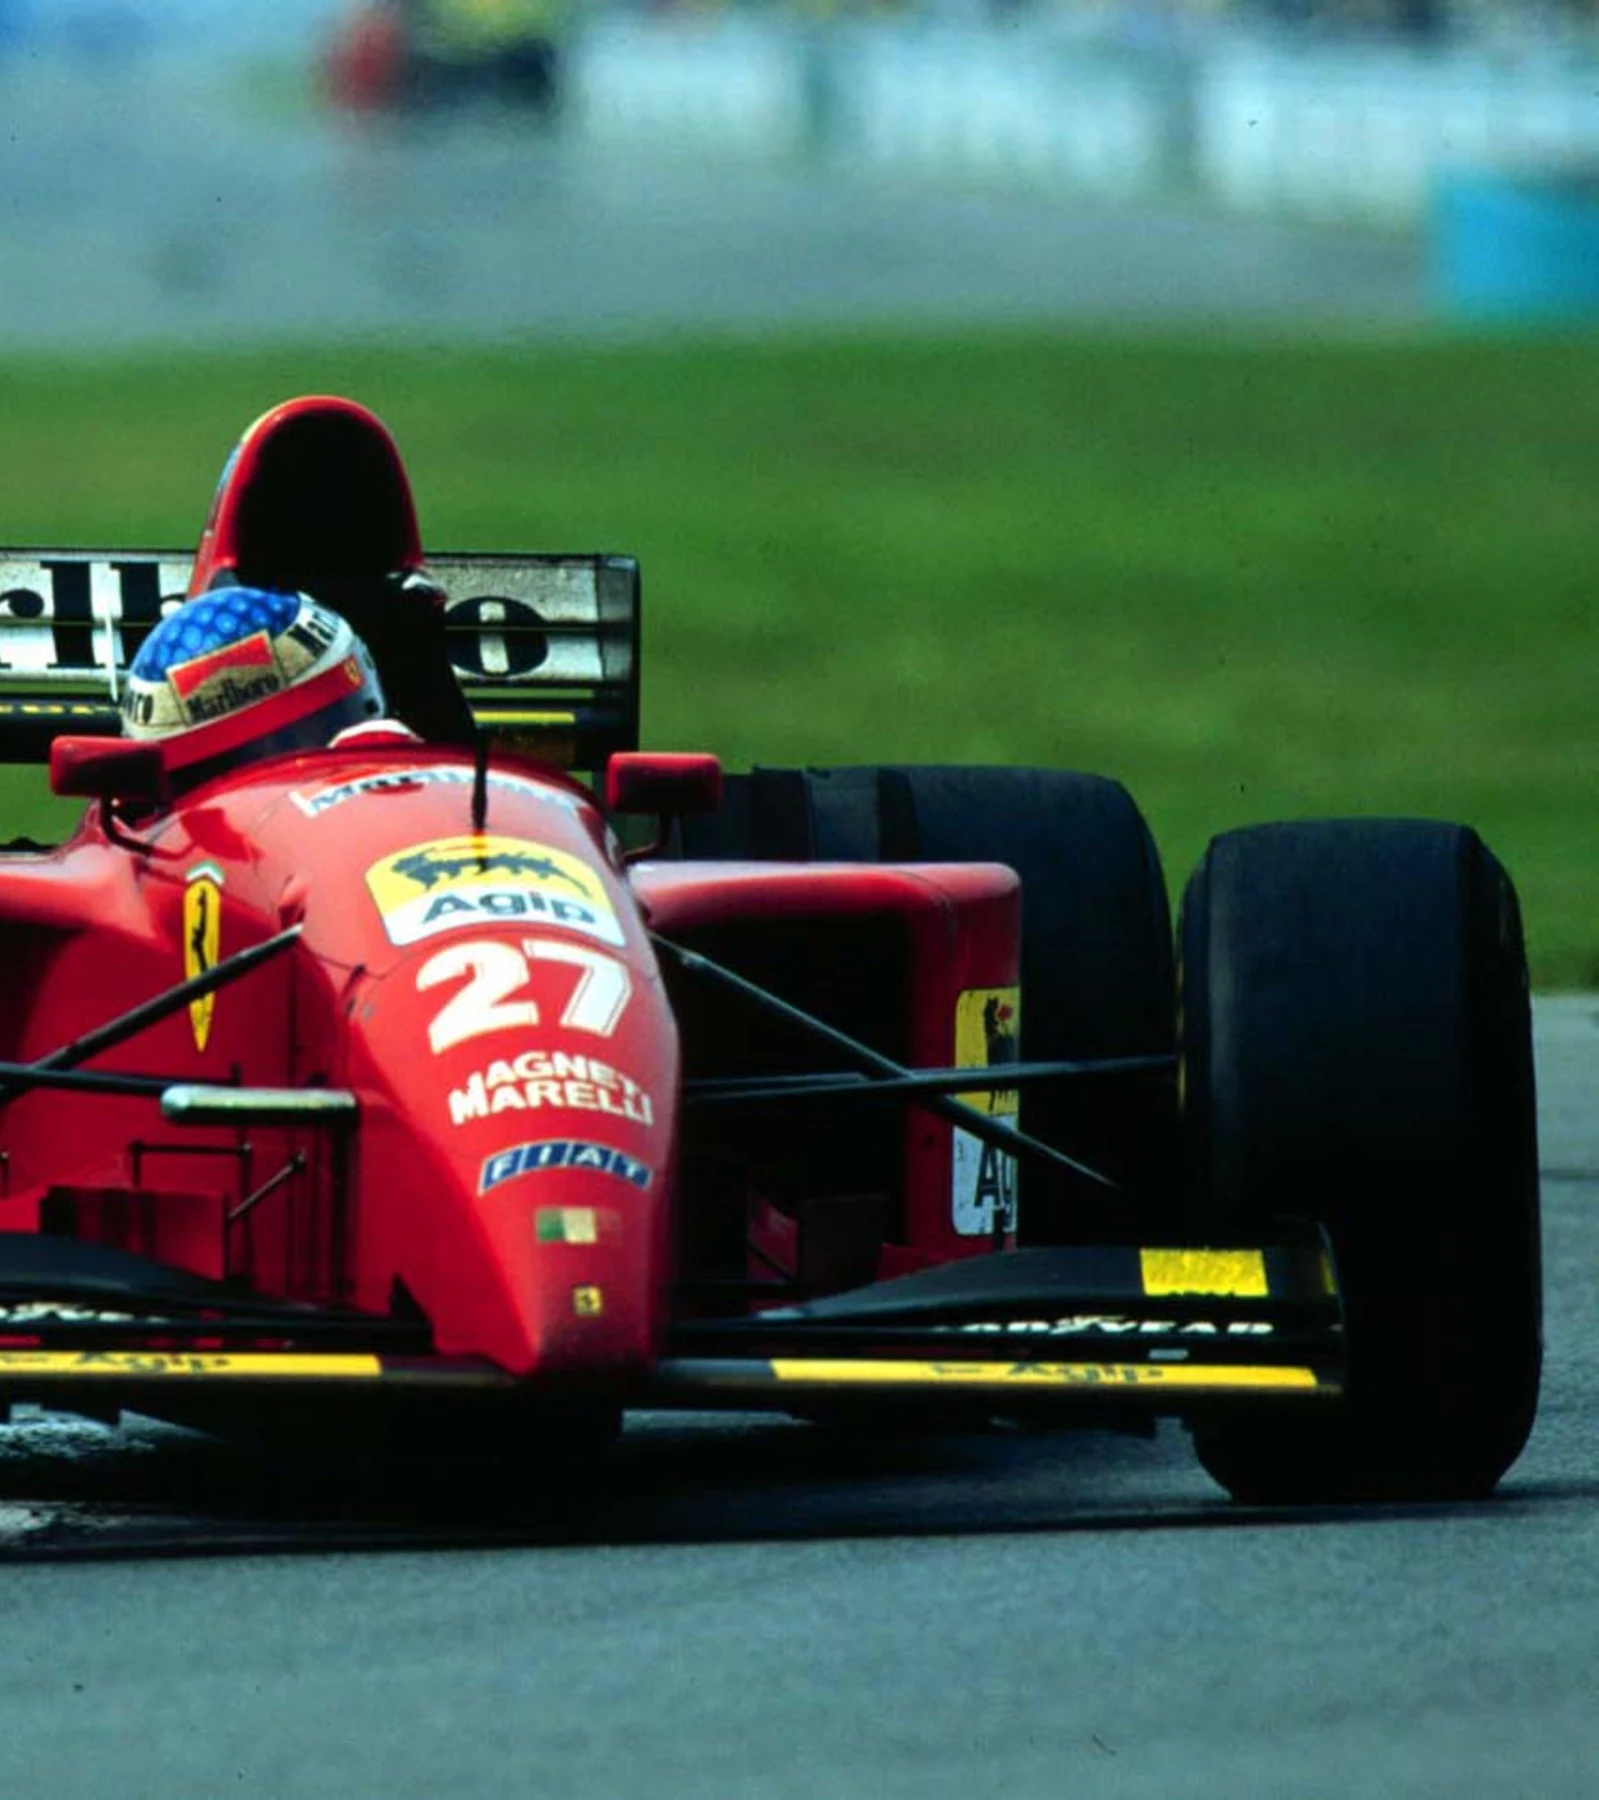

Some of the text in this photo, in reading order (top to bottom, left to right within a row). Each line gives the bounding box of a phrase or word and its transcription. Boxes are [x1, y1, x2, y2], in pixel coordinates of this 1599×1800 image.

[422, 890, 598, 925] Agip
[416, 939, 633, 1054] 27
[449, 1073, 654, 1126] MARELLI
[484, 1142, 645, 1183] FIAT
